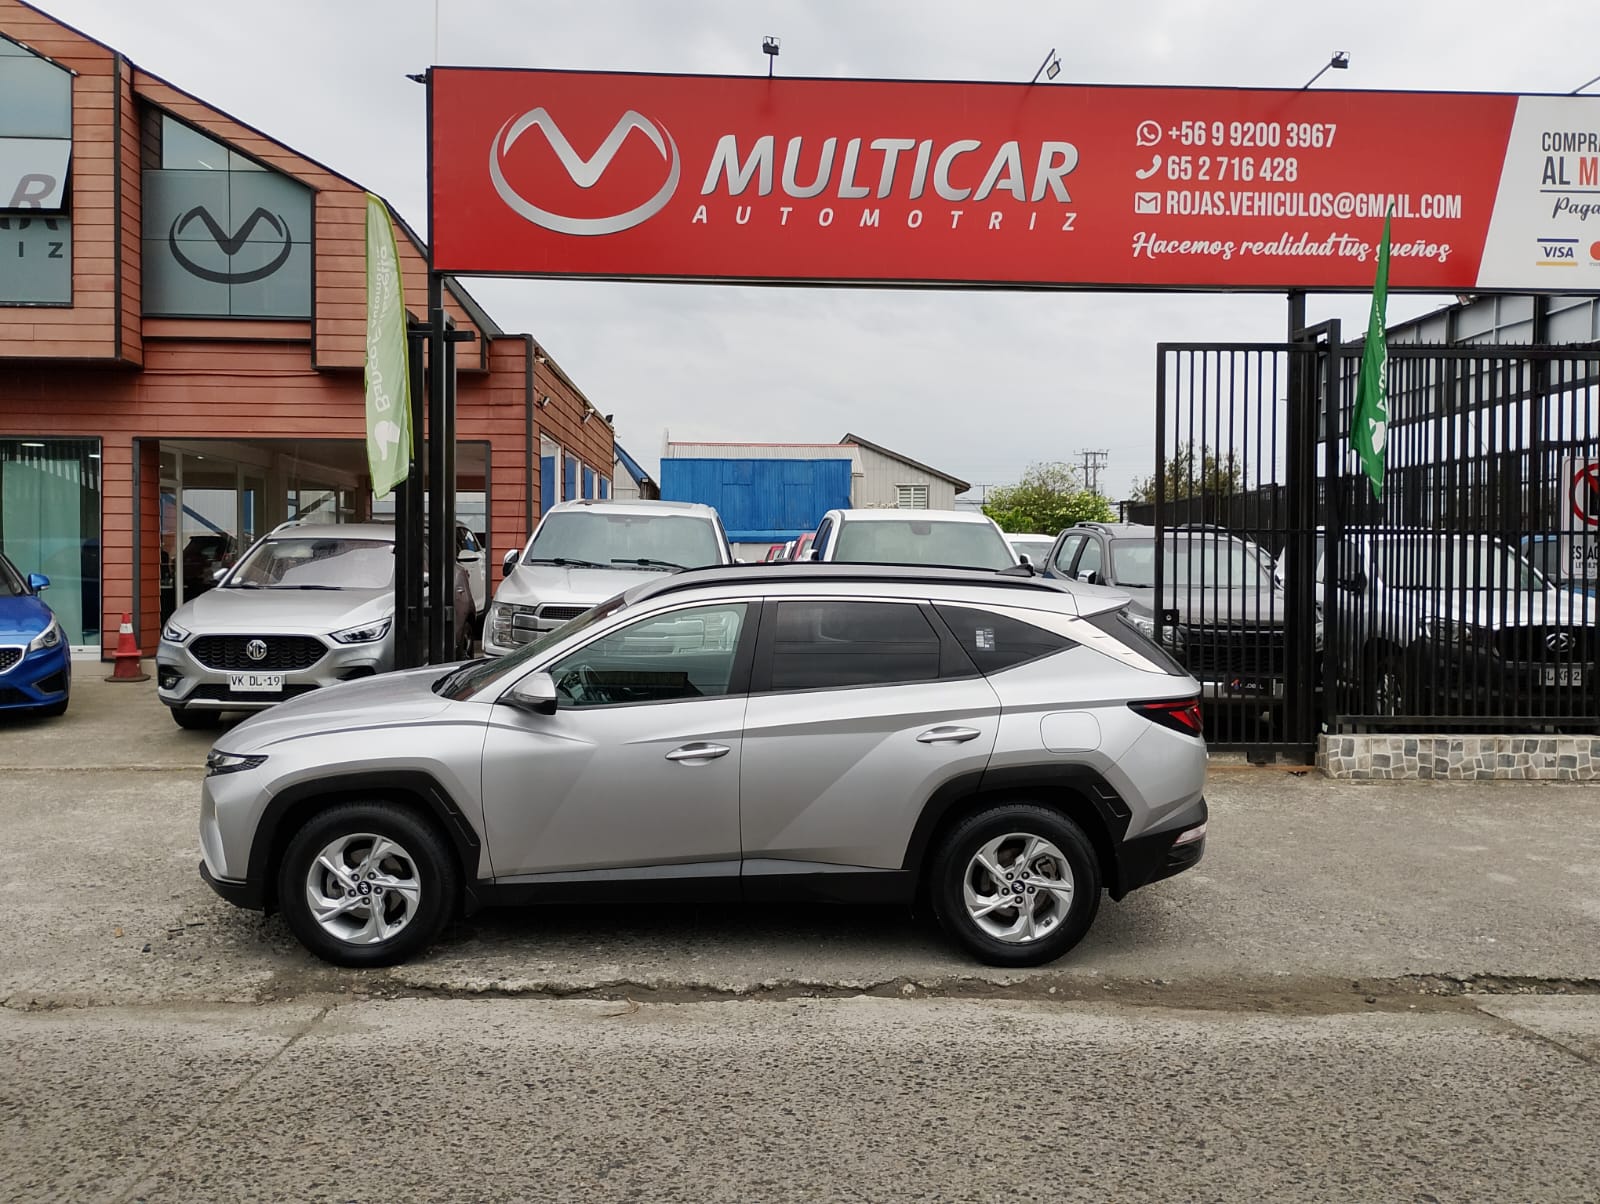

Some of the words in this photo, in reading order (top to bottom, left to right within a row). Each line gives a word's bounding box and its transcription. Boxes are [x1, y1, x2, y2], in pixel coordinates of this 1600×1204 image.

[1168, 121, 1206, 146] +56
[1211, 121, 1224, 147] 9
[1230, 121, 1281, 148] 9200
[1286, 123, 1337, 148] 3967
[1541, 132, 1600, 153] COMPR
[700, 134, 1079, 203] MULTICAR
[1167, 155, 1192, 180] 65
[1198, 156, 1210, 181] 2
[1216, 156, 1254, 182] 716
[1259, 157, 1298, 182] 428
[1541, 155, 1571, 186] AL
[692, 204, 1077, 231] AUTOMOTRIZ
[1166, 190, 1462, 220] ROJAS.VEHICULOS@GMAIL.COM
[1132, 231, 1237, 260] Hacemos
[1239, 232, 1336, 256] realidad
[1336, 232, 1372, 262] tus
[1541, 246, 1575, 258] VISA
[231, 675, 244, 686] VK
